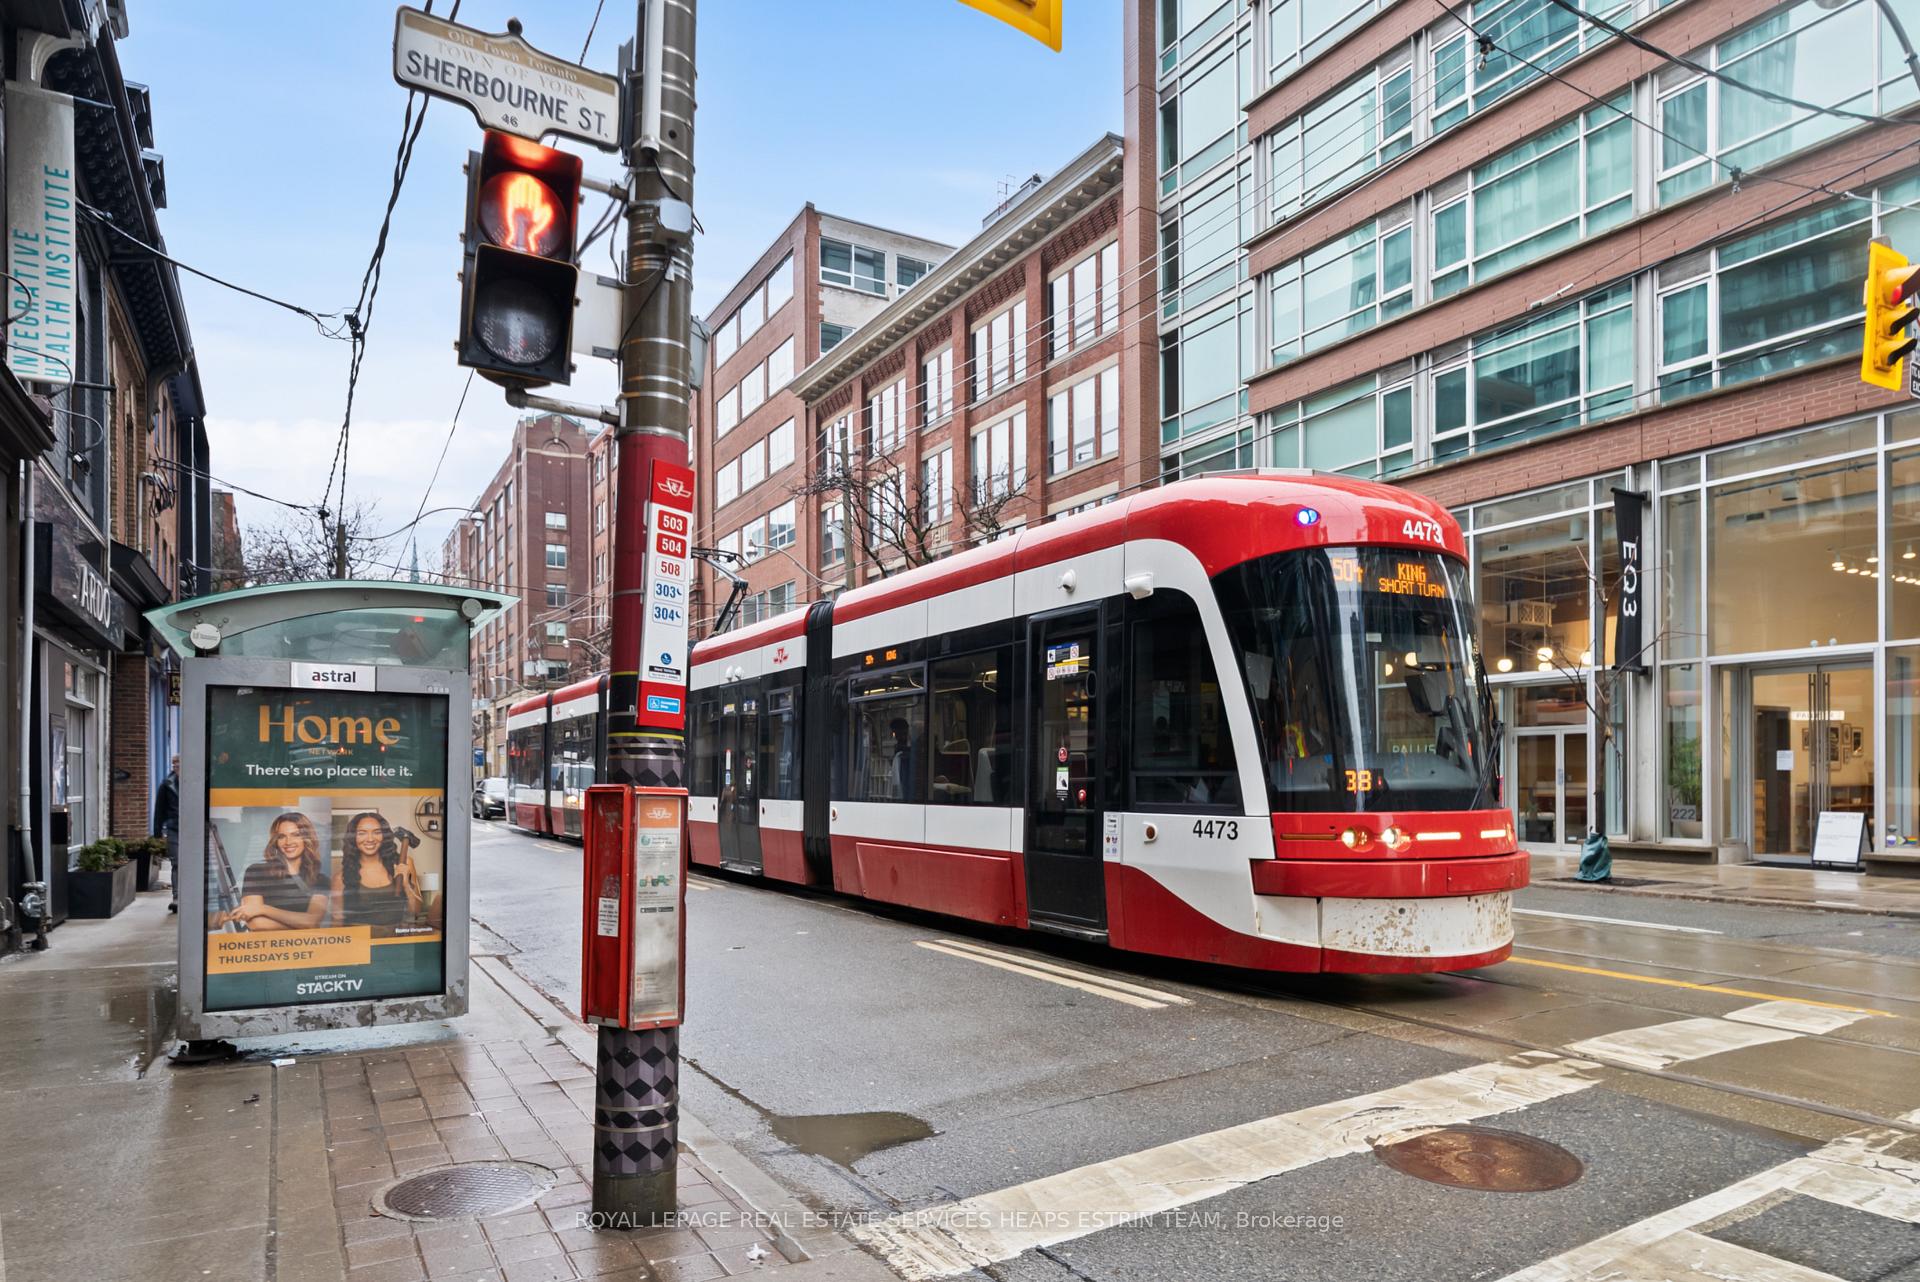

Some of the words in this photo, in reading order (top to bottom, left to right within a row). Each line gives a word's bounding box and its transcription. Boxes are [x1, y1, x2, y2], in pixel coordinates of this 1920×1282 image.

[448, 29, 475, 48] Old
[483, 40, 521, 63] Town
[527, 54, 578, 82] Toronto
[437, 41, 494, 72] TOWN
[504, 62, 529, 82] OF
[538, 74, 587, 102] YORK
[406, 50, 569, 125] SHERBOURNE
[578, 108, 610, 138] ST.
[501, 114, 519, 128] 46
[44, 164, 71, 289] INSTITUTE
[13, 228, 40, 374] INTEGRATIVE
[44, 300, 71, 379] HEALTH
[662, 516, 684, 532] 503
[1402, 519, 1442, 544] 4473
[661, 538, 682, 554] 504
[660, 561, 681, 577] 508
[1397, 562, 1427, 583] KING
[1379, 578, 1414, 594] SHORT
[1417, 582, 1446, 597] TURN
[1622, 541, 1638, 617] EQ3
[655, 582, 677, 599] 303
[654, 604, 675, 620] 304
[311, 669, 357, 684] astral
[258, 704, 401, 745] Home
[308, 747, 354, 756] NETWORK
[245, 764, 301, 777] There's
[303, 767, 323, 777] no
[326, 765, 368, 781] place
[370, 765, 397, 778] like
[399, 766, 413, 777] it.
[1344, 769, 1373, 792] 38
[1672, 808, 1696, 819] 222
[1192, 819, 1238, 840] 4473
[218, 940, 267, 951] HONEST
[270, 935, 352, 949] RENOVATIONS
[218, 952, 290, 965] THURSDAYS
[293, 951, 314, 961] 9ET
[296, 979, 363, 995] STACKTV
